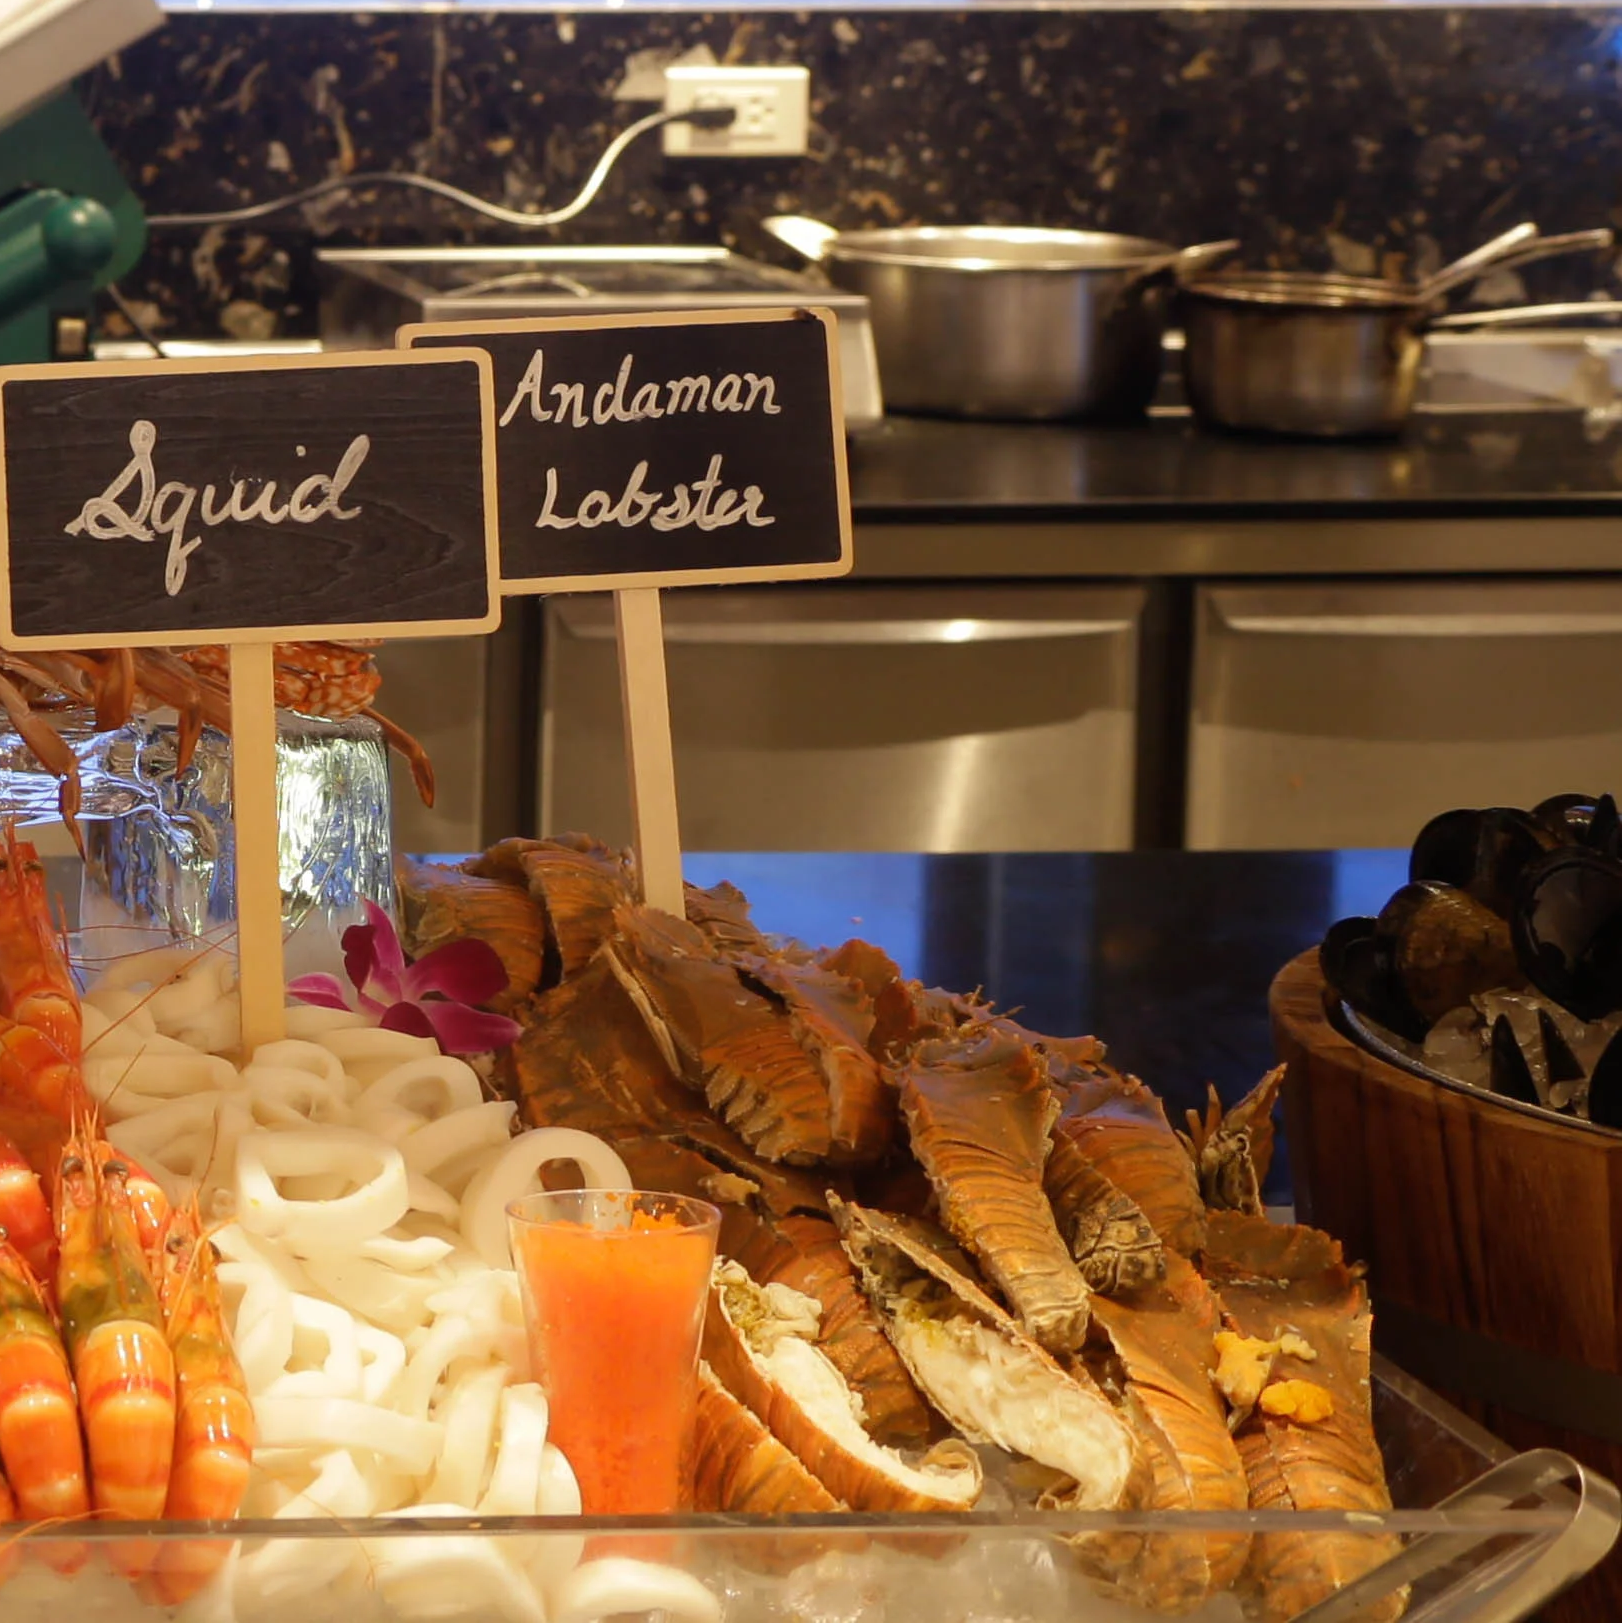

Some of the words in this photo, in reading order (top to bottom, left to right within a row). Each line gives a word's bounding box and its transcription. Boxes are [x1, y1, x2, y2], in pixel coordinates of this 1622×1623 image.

[499, 349, 781, 427] Andaman
[64, 420, 370, 596] Squid
[536, 454, 775, 531] Lobster
